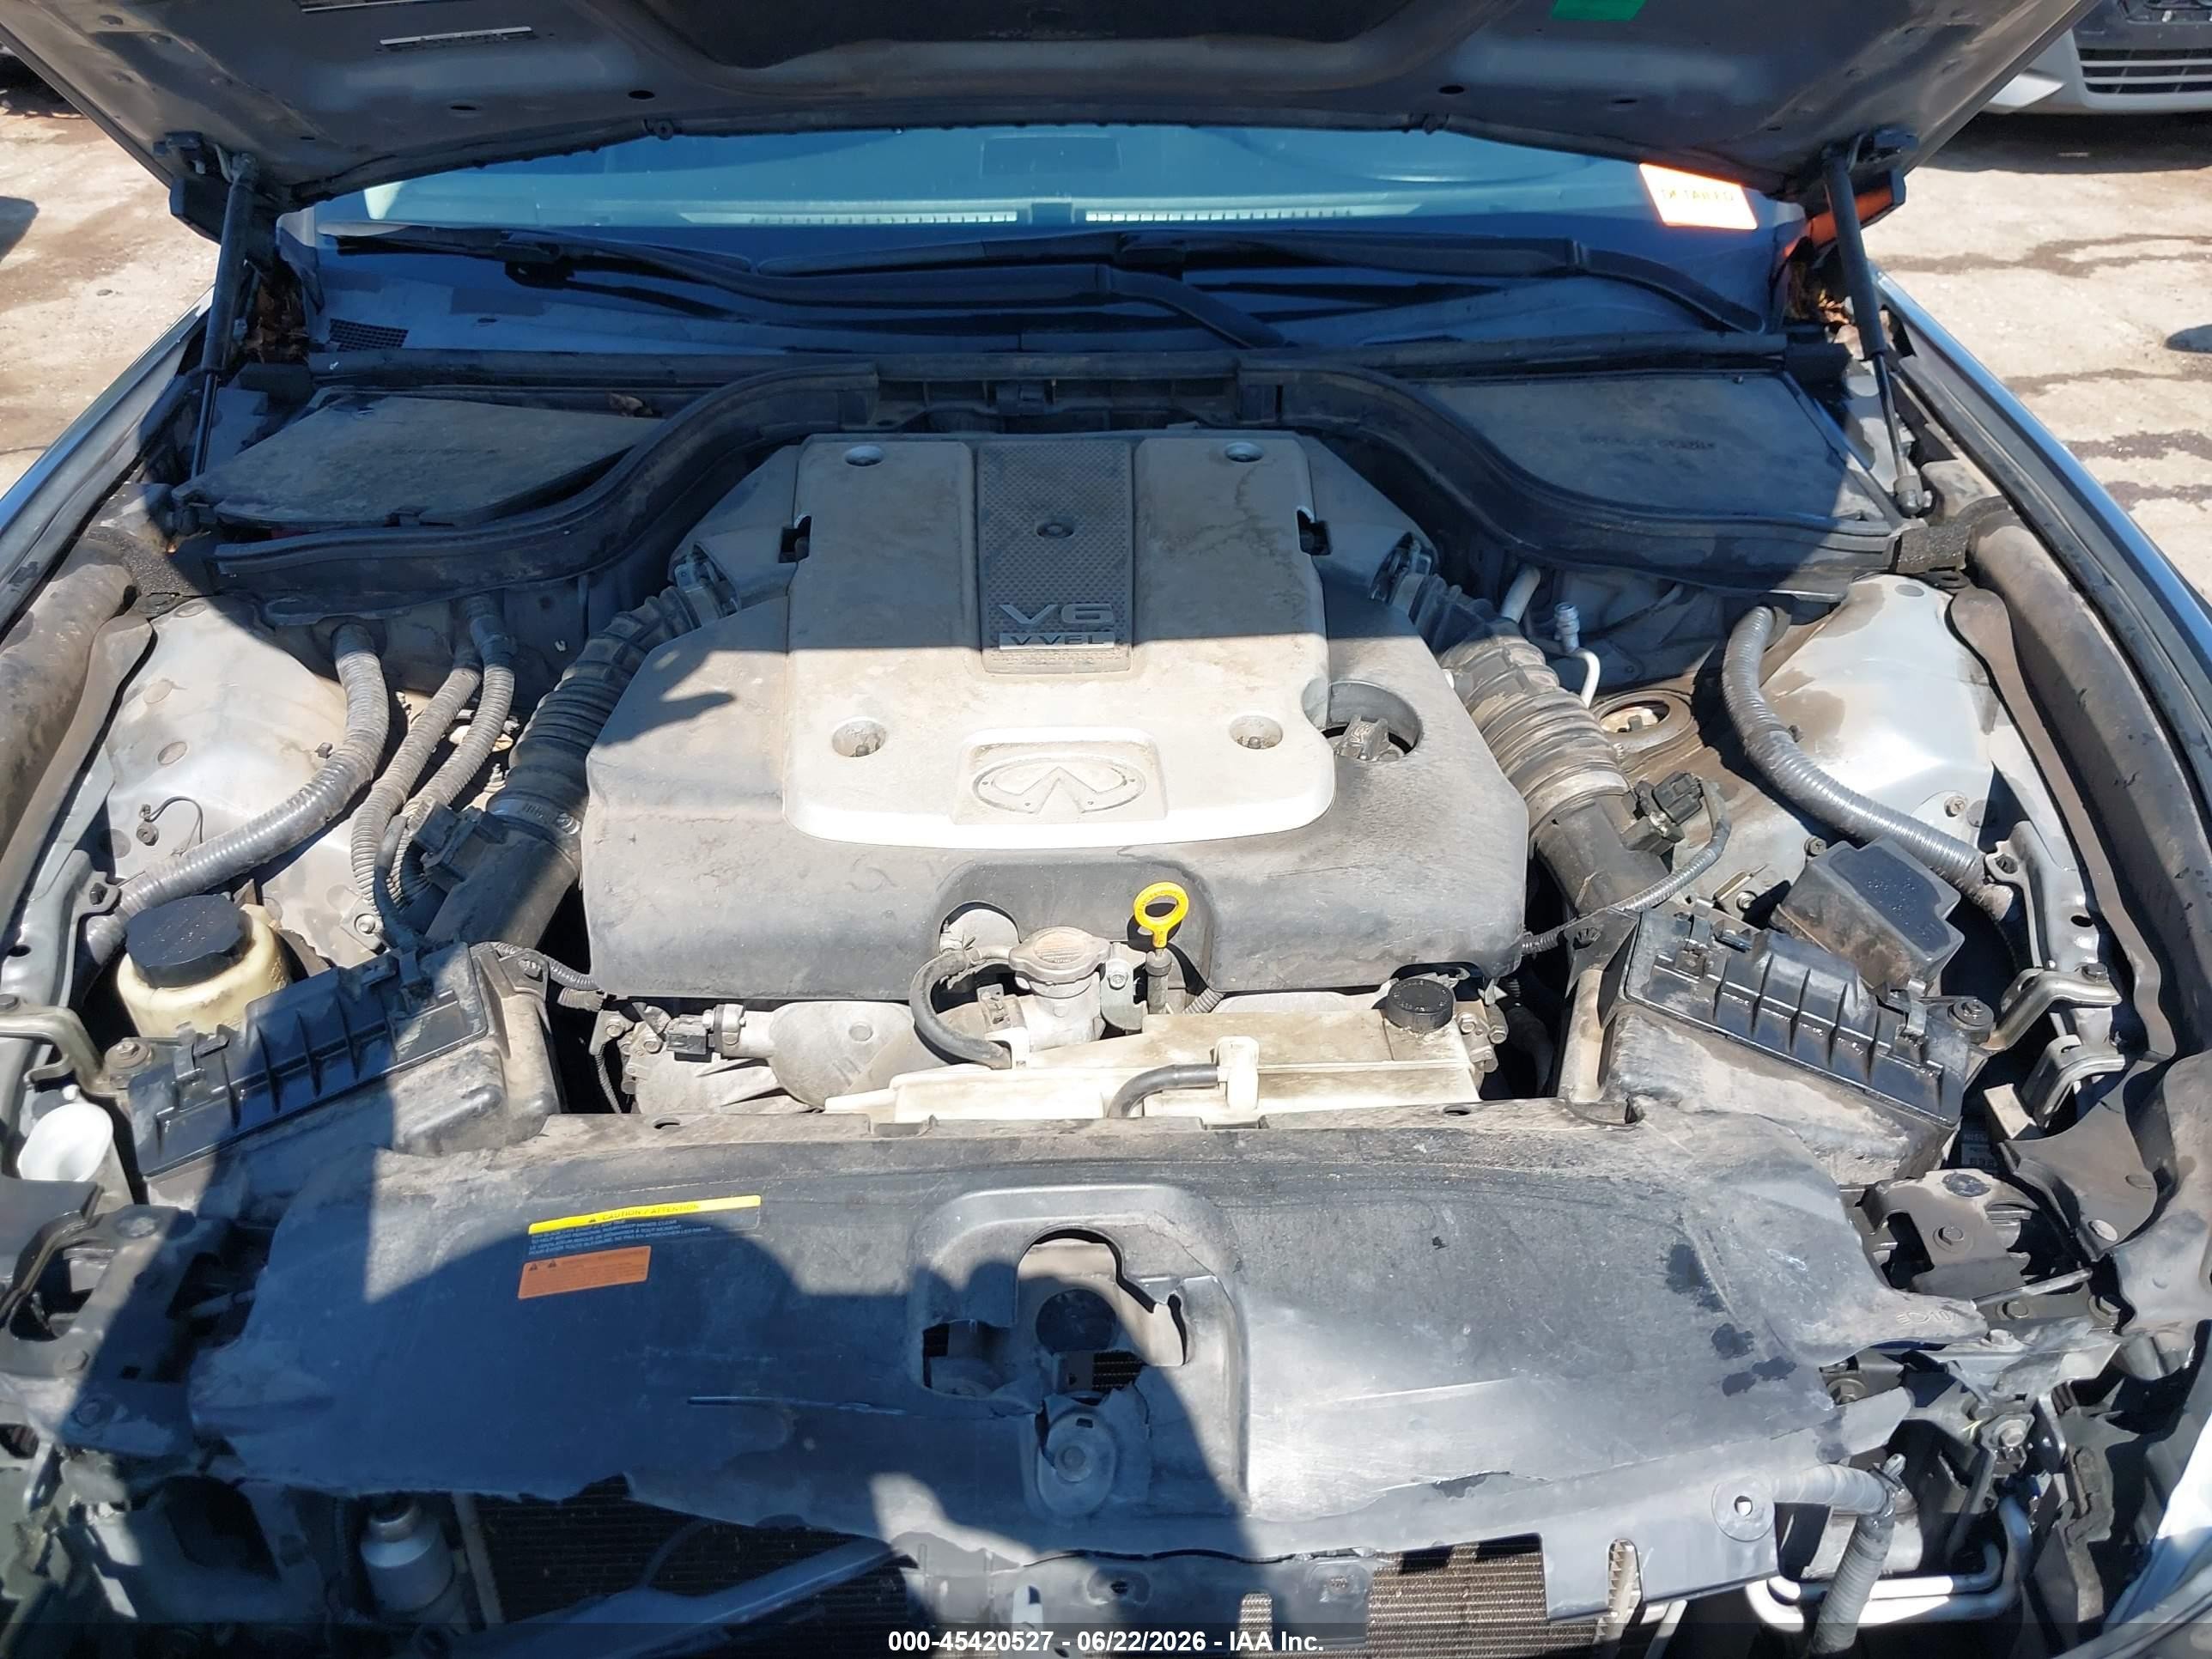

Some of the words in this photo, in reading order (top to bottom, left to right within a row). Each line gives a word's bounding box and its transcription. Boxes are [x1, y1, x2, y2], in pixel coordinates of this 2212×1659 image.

[999, 603, 1114, 626] V6
[1010, 635, 1104, 646] VVEL
[602, 1210, 641, 1220] CAUTION
[652, 1204, 700, 1213] ATTENTION
